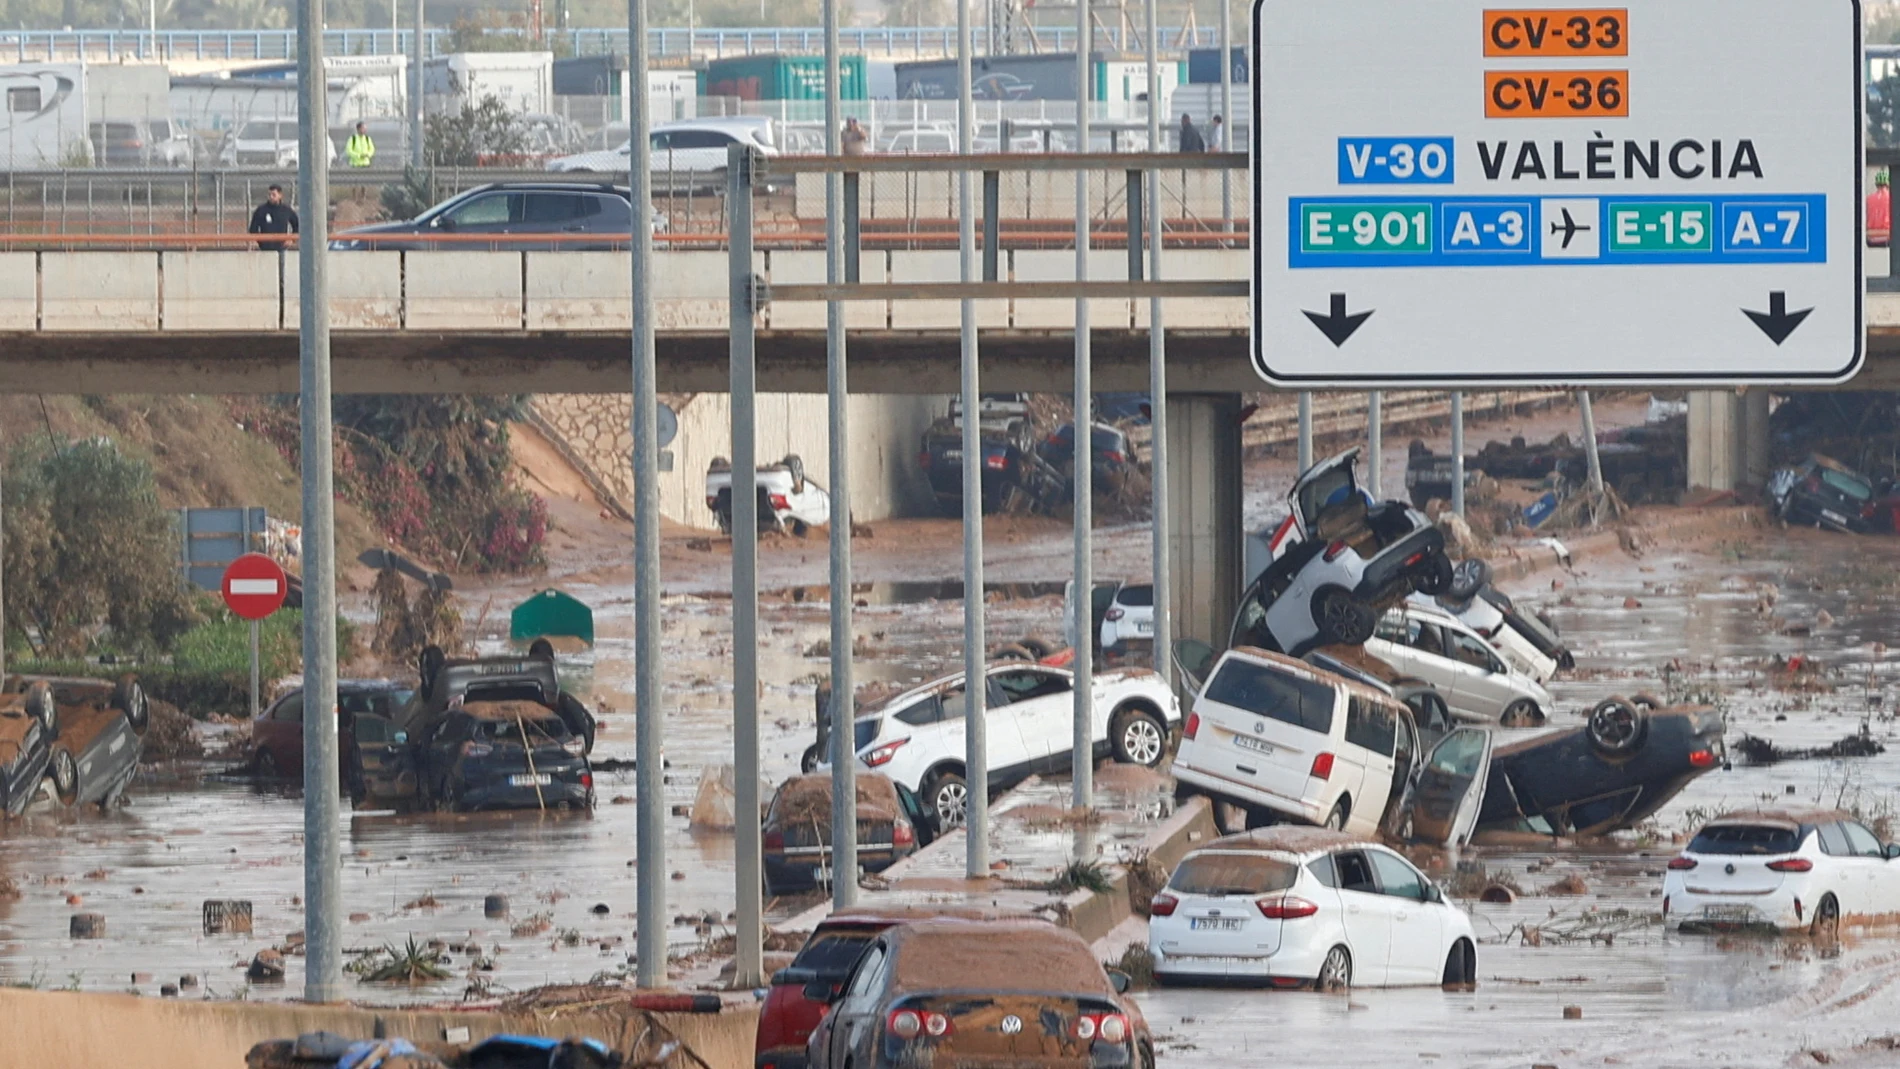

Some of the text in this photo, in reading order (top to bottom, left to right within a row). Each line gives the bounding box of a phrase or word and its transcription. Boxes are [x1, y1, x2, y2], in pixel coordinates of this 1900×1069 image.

[1491, 16, 1620, 50] CV-33
[1492, 76, 1621, 111] CV-36
[1346, 131, 1764, 180] V-30 VALÈNCIA
[1309, 211, 1801, 245] E-901 A-3 E-15 A-7
